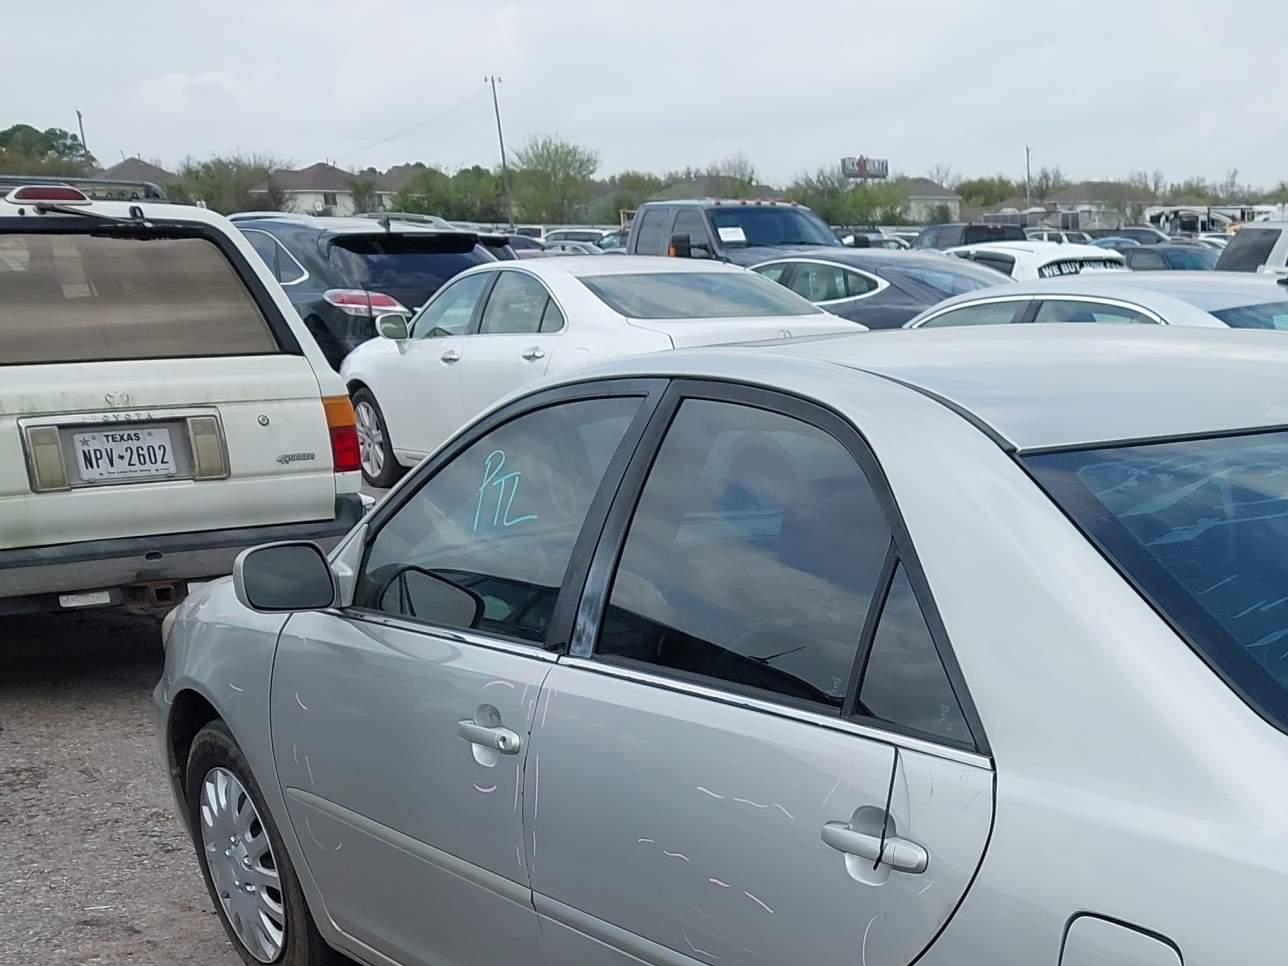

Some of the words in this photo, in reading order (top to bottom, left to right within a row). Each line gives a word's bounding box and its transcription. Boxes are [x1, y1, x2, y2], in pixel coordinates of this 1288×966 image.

[1042, 264, 1061, 277] WE
[1060, 263, 1081, 274] BUY
[103, 432, 141, 443] TEXAS
[82, 447, 115, 470] NPV
[125, 444, 169, 467] 2602
